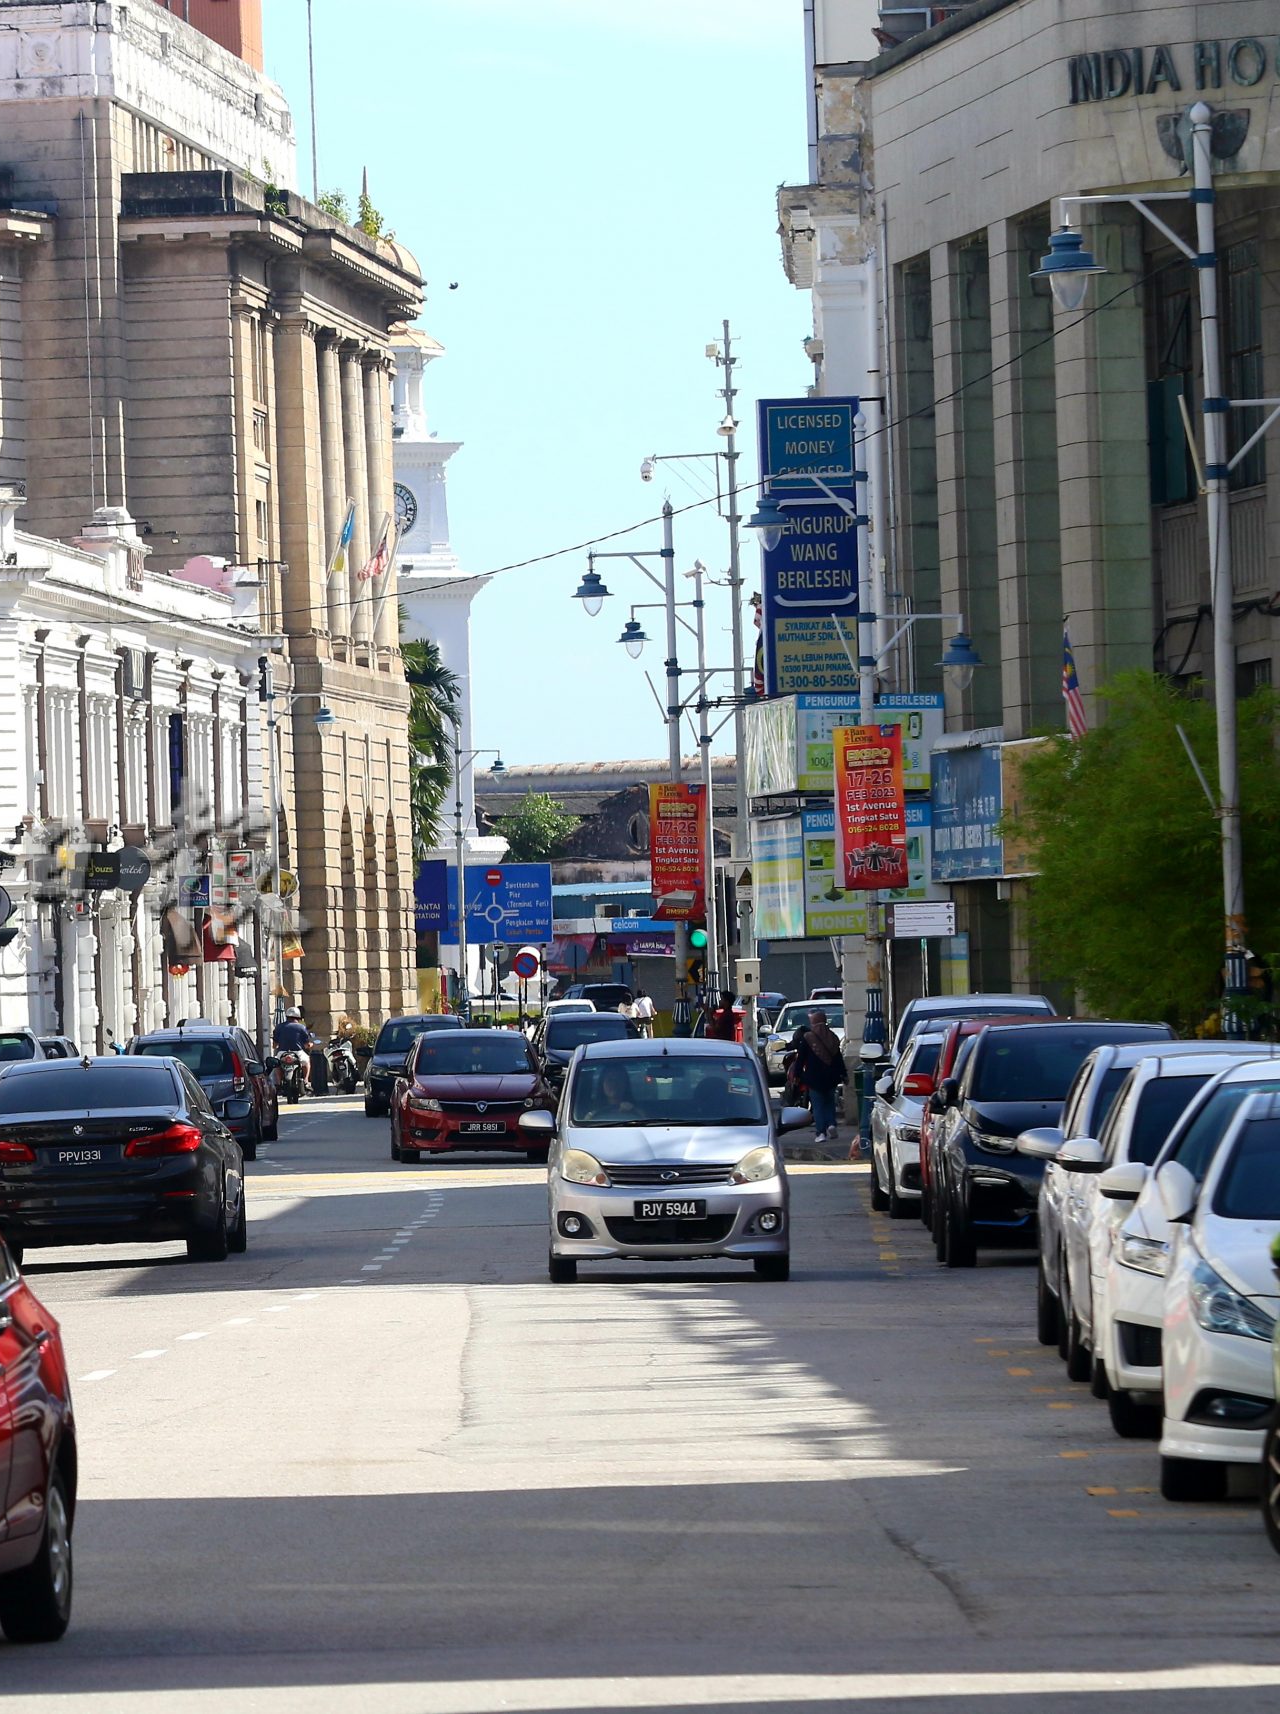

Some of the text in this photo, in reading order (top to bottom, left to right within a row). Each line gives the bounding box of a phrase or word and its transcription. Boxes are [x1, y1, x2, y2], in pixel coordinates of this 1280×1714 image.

[1069, 37, 1280, 104] INDIA HO
[777, 414, 842, 429] LICENSED
[785, 440, 835, 455] MONEY
[781, 515, 853, 535] ENGURUP
[790, 543, 837, 562] WANG
[777, 569, 852, 589] BERLESEN
[785, 621, 821, 631] SYARIKAT
[802, 663, 825, 673] PULAU
[779, 674, 857, 688] 1-300-80-5050
[805, 695, 857, 707] PENGURUP
[889, 695, 937, 706] BERLESEN
[846, 768, 892, 788] 17-26
[846, 786, 896, 801] FEB 2023
[846, 801, 898, 812] 1st Avenue
[846, 812, 899, 824] Tingkat Satu
[656, 820, 698, 835] 17-26
[880, 823, 900, 831] 8028
[655, 835, 699, 845] FEB 2023
[655, 846, 666, 854] 1st
[655, 856, 699, 865] Tingkat Satu
[613, 919, 639, 929] celcom
[467, 1123, 481, 1131] JRR
[642, 1201, 697, 1217] PJY 5944
